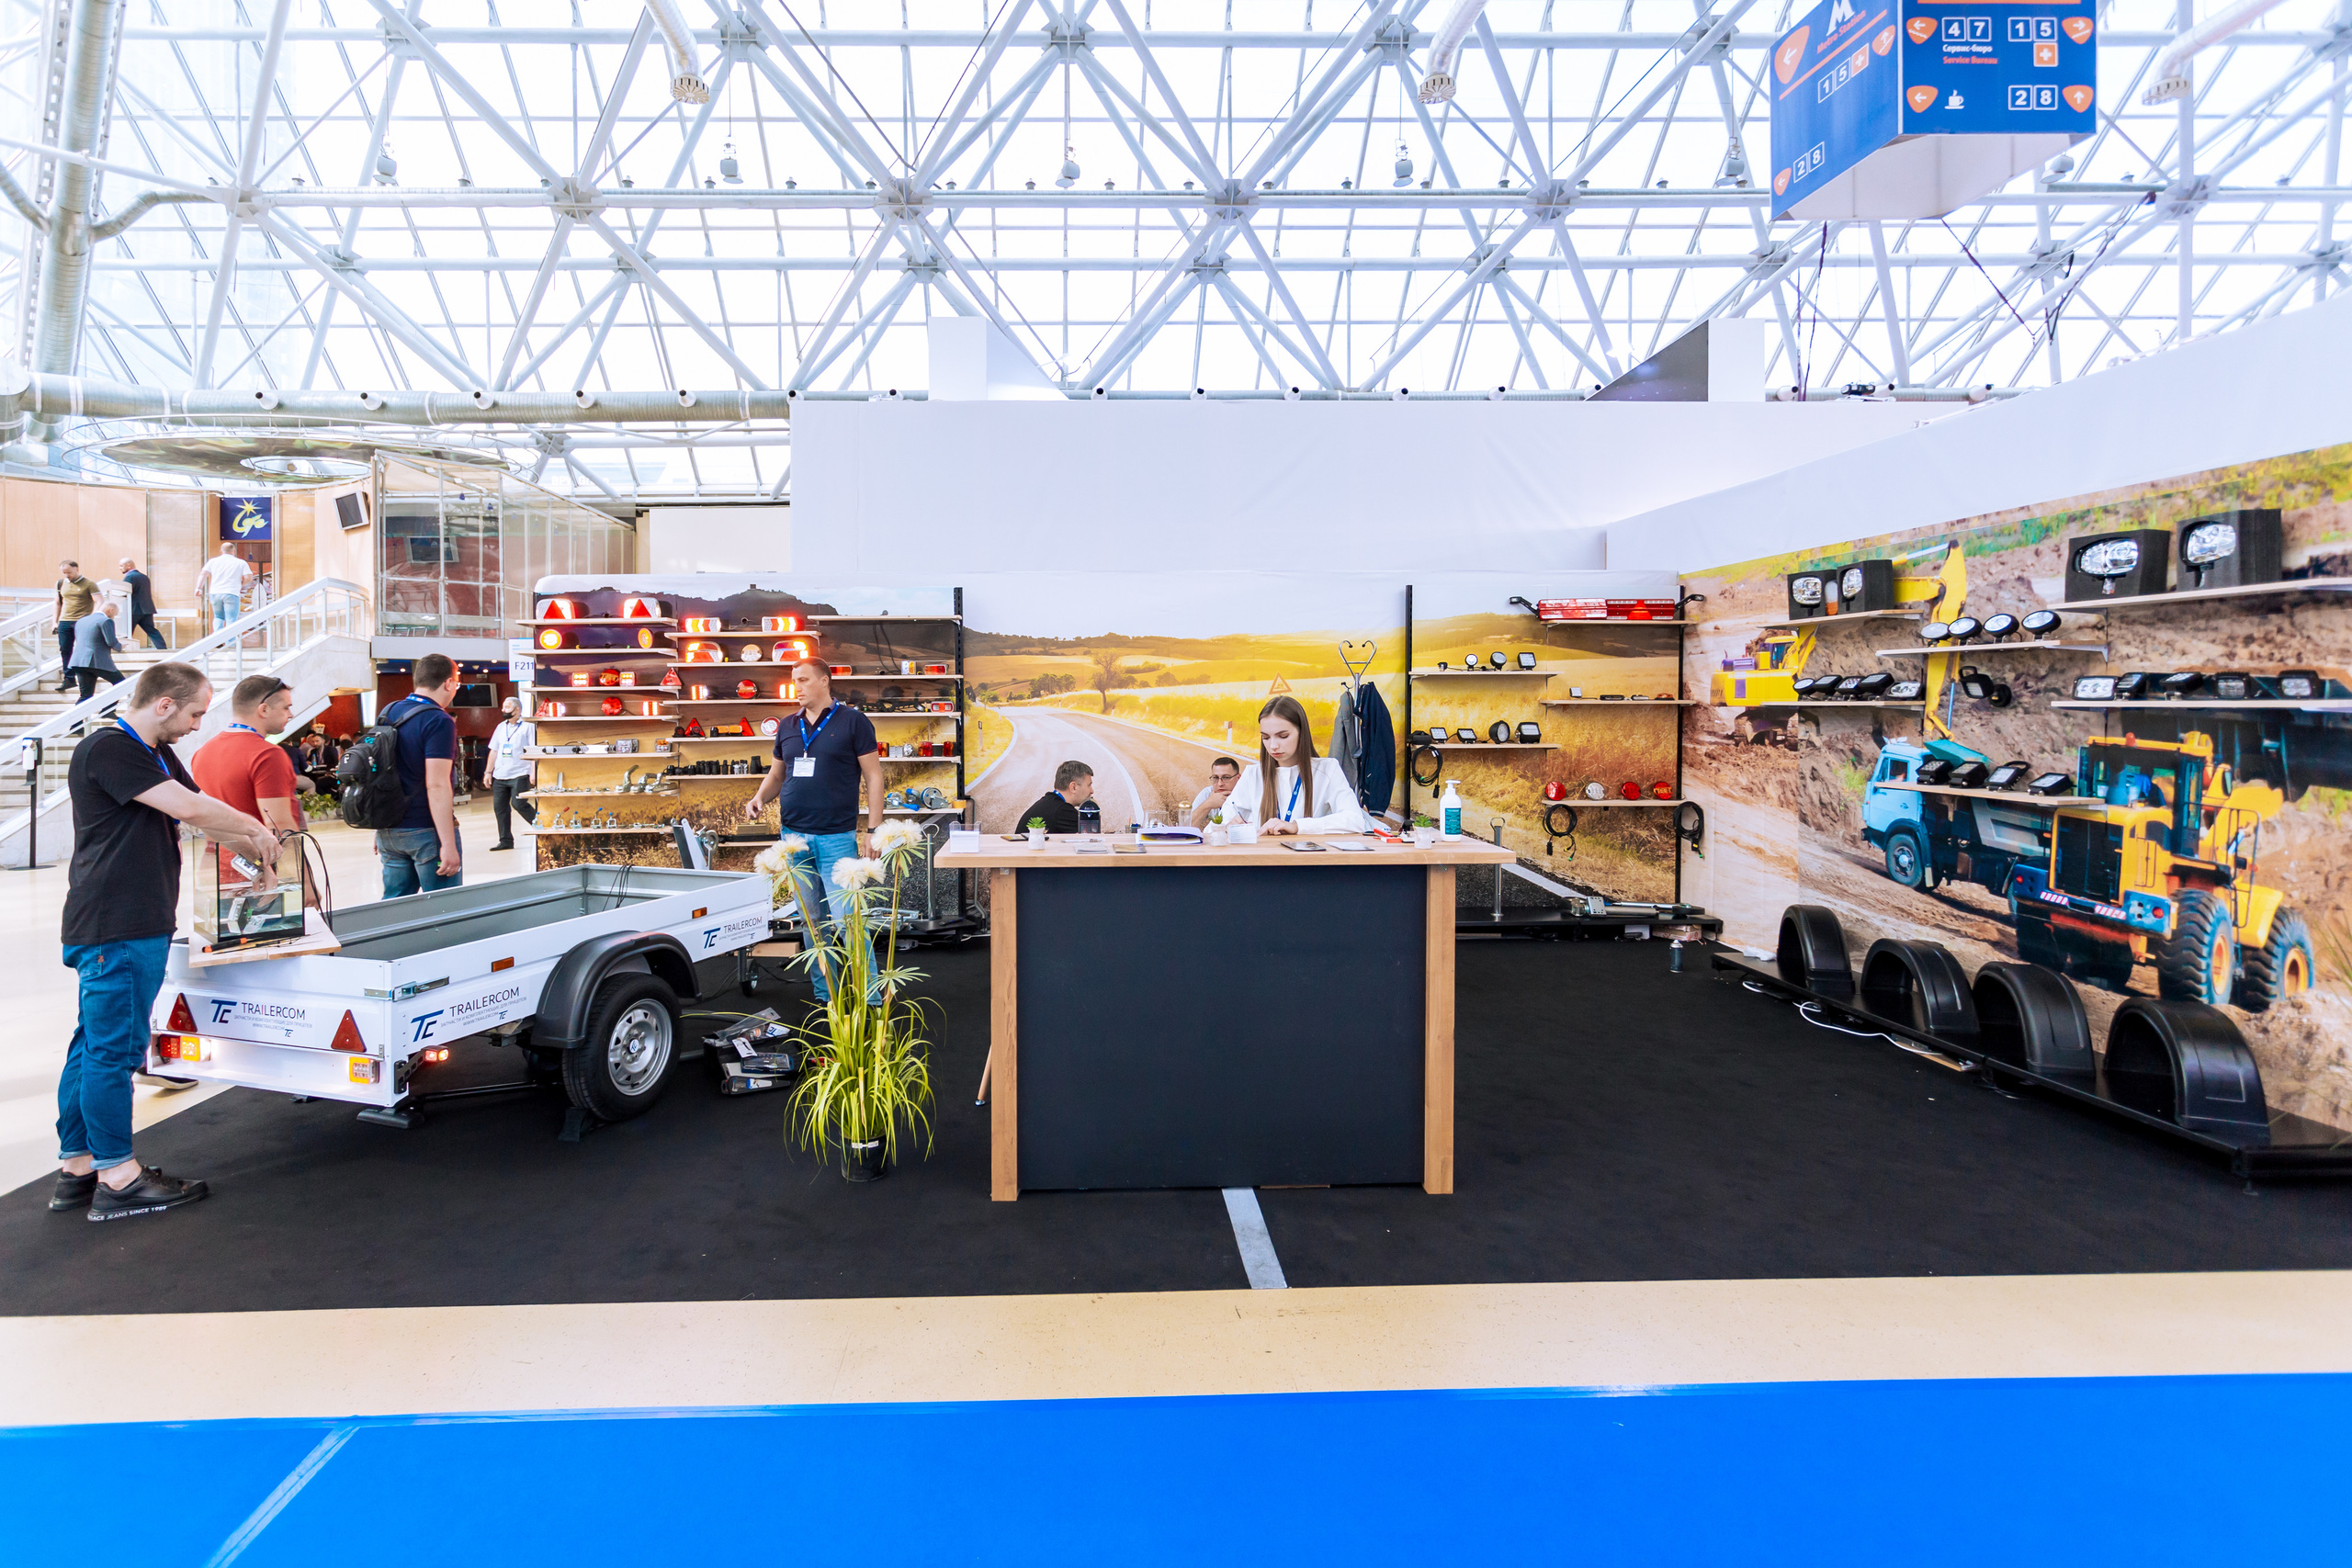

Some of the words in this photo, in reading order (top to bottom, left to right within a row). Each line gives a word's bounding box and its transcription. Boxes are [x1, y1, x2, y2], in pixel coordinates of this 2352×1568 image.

[1817, 33, 1838, 54] Metro
[1838, 10, 1866, 37] Station
[1942, 44, 1993, 53] Сервис-бюро
[1942, 56, 1970, 64] Service
[1971, 56, 1998, 64] Bureau
[723, 916, 763, 934] TRAILERCOM
[449, 987, 519, 1017] TRAILERCOM
[241, 1002, 306, 1021] TRAILERCOM
[107, 1212, 128, 1220] JEANS
